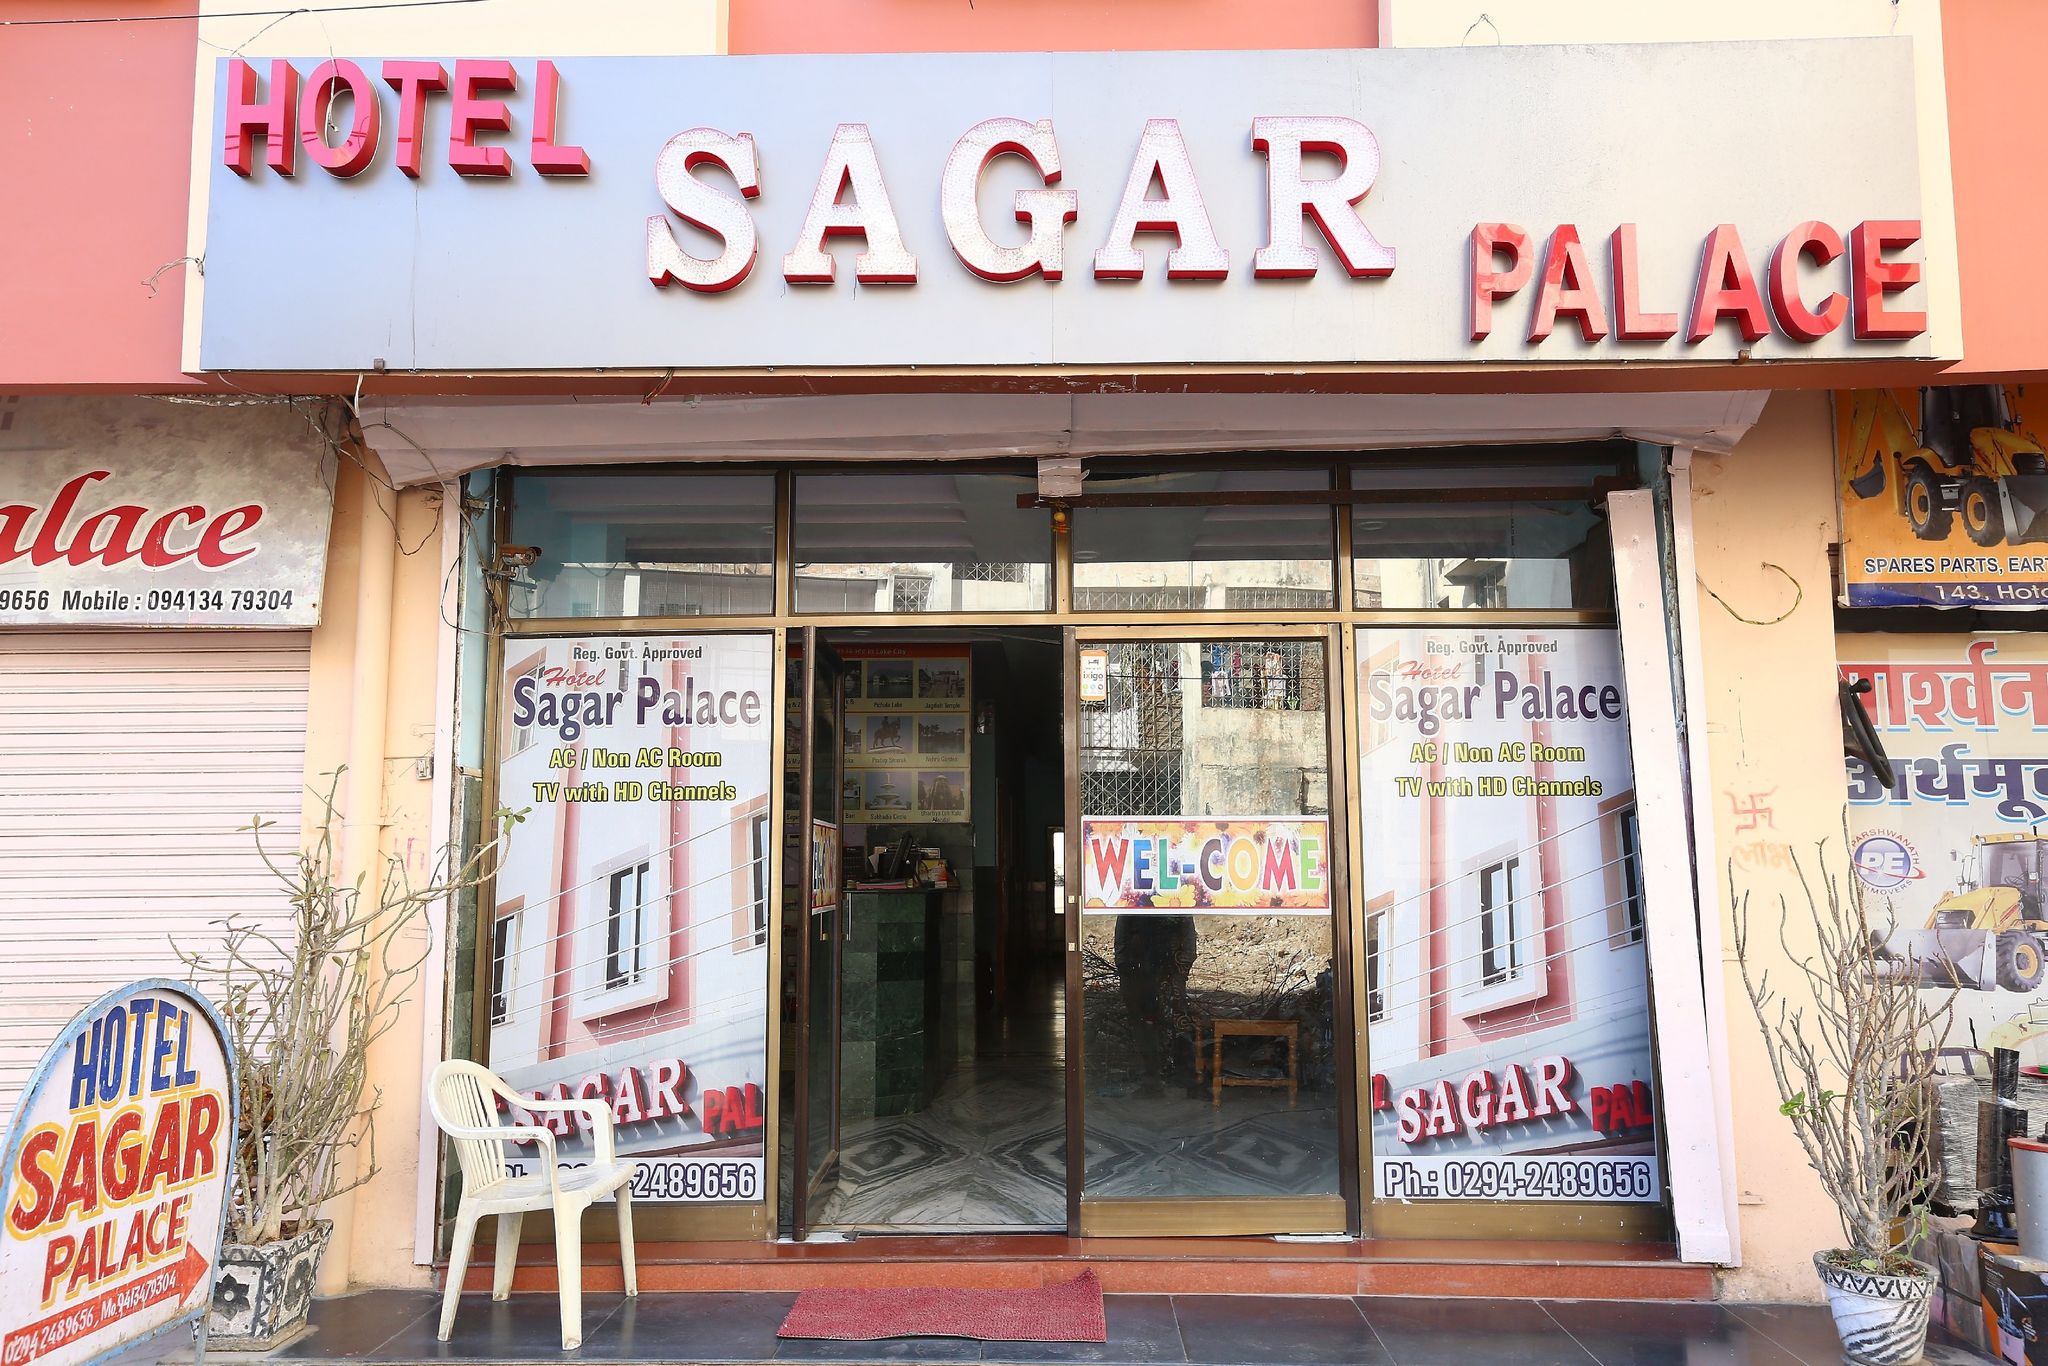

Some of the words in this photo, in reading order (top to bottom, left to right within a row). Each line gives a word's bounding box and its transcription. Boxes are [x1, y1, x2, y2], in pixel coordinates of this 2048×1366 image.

[224, 59, 590, 178] HOTEL
[646, 116, 1396, 294] SAGAR
[1469, 220, 1927, 344] PALACE
[1865, 557, 1935, 573] SPARES
[1940, 557, 2004, 575] PARTS,
[62, 590, 129, 611] Mobile
[147, 589, 224, 611] 094134
[231, 589, 293, 611] 79304
[573, 647, 600, 662] Reg.
[605, 647, 637, 659] Govt.
[642, 647, 702, 661] Approved
[1427, 641, 1454, 656] Reg.
[1459, 641, 1492, 654] Govt.
[1498, 640, 1558, 655] Approved
[543, 666, 606, 687] Hotel
[1083, 671, 1104, 681] ixigo
[1399, 660, 1463, 680] Hotel
[513, 677, 623, 741] Sagar
[637, 677, 761, 725] Palace
[1369, 671, 1481, 736] Sagar
[1495, 671, 1623, 720] Palace
[549, 749, 576, 768] AC
[592, 749, 630, 768] Non
[636, 749, 663, 768] AC
[668, 748, 721, 767] Room
[1410, 743, 1437, 763] AC
[1454, 743, 1492, 762] Non
[1498, 743, 1525, 763] AC
[1531, 743, 1584, 762] Room
[533, 782, 560, 802] TV
[564, 782, 608, 801] with
[614, 782, 642, 801] HD
[648, 781, 736, 801] Channels
[1396, 777, 1422, 797] TV
[1427, 778, 1472, 797] with
[1478, 777, 1506, 796] HD
[1513, 776, 1603, 796] Channels
[1851, 828, 1920, 864] PARSHWANATH
[1091, 837, 1321, 892] WEL-COME
[69, 998, 199, 1112] HOTEL
[703, 1082, 764, 1135] PAL
[1397, 1056, 1578, 1144] SAGAR
[1590, 1079, 1654, 1132] PAL
[9, 1093, 222, 1233] SAGAR
[1384, 1161, 1438, 1197] Ph.:
[1445, 1161, 1651, 1197] 0294-2489656
[41, 1194, 190, 1305] PALACE
[5, 1331, 39, 1365] 0294
